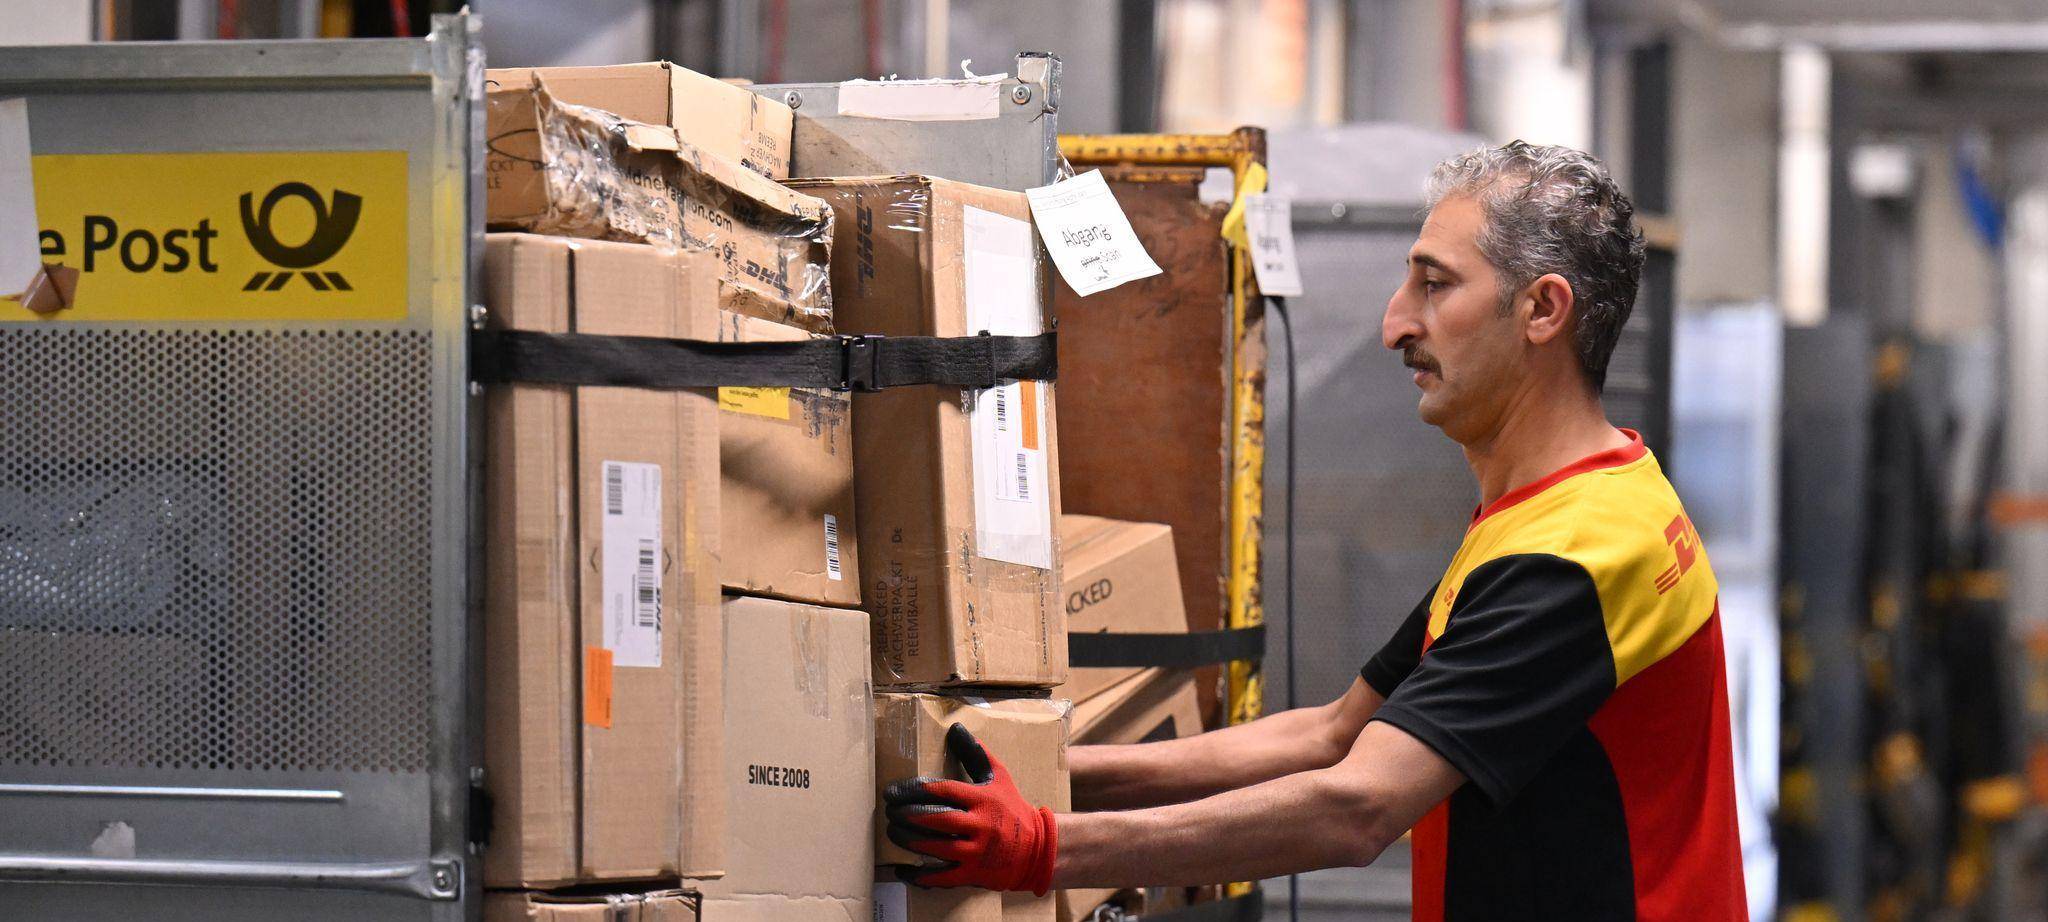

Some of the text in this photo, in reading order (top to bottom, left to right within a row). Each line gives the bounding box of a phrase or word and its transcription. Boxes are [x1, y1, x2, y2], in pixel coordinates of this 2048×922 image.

[83, 214, 219, 274] Post
[855, 196, 875, 292] DHL
[1060, 224, 1113, 248] Abgang
[876, 580, 888, 655] REPACKED
[892, 559, 905, 674] NACHVERPACKT
[904, 575, 920, 657] RÉEMBALLÉ
[748, 764, 810, 789] SINCE 2008
